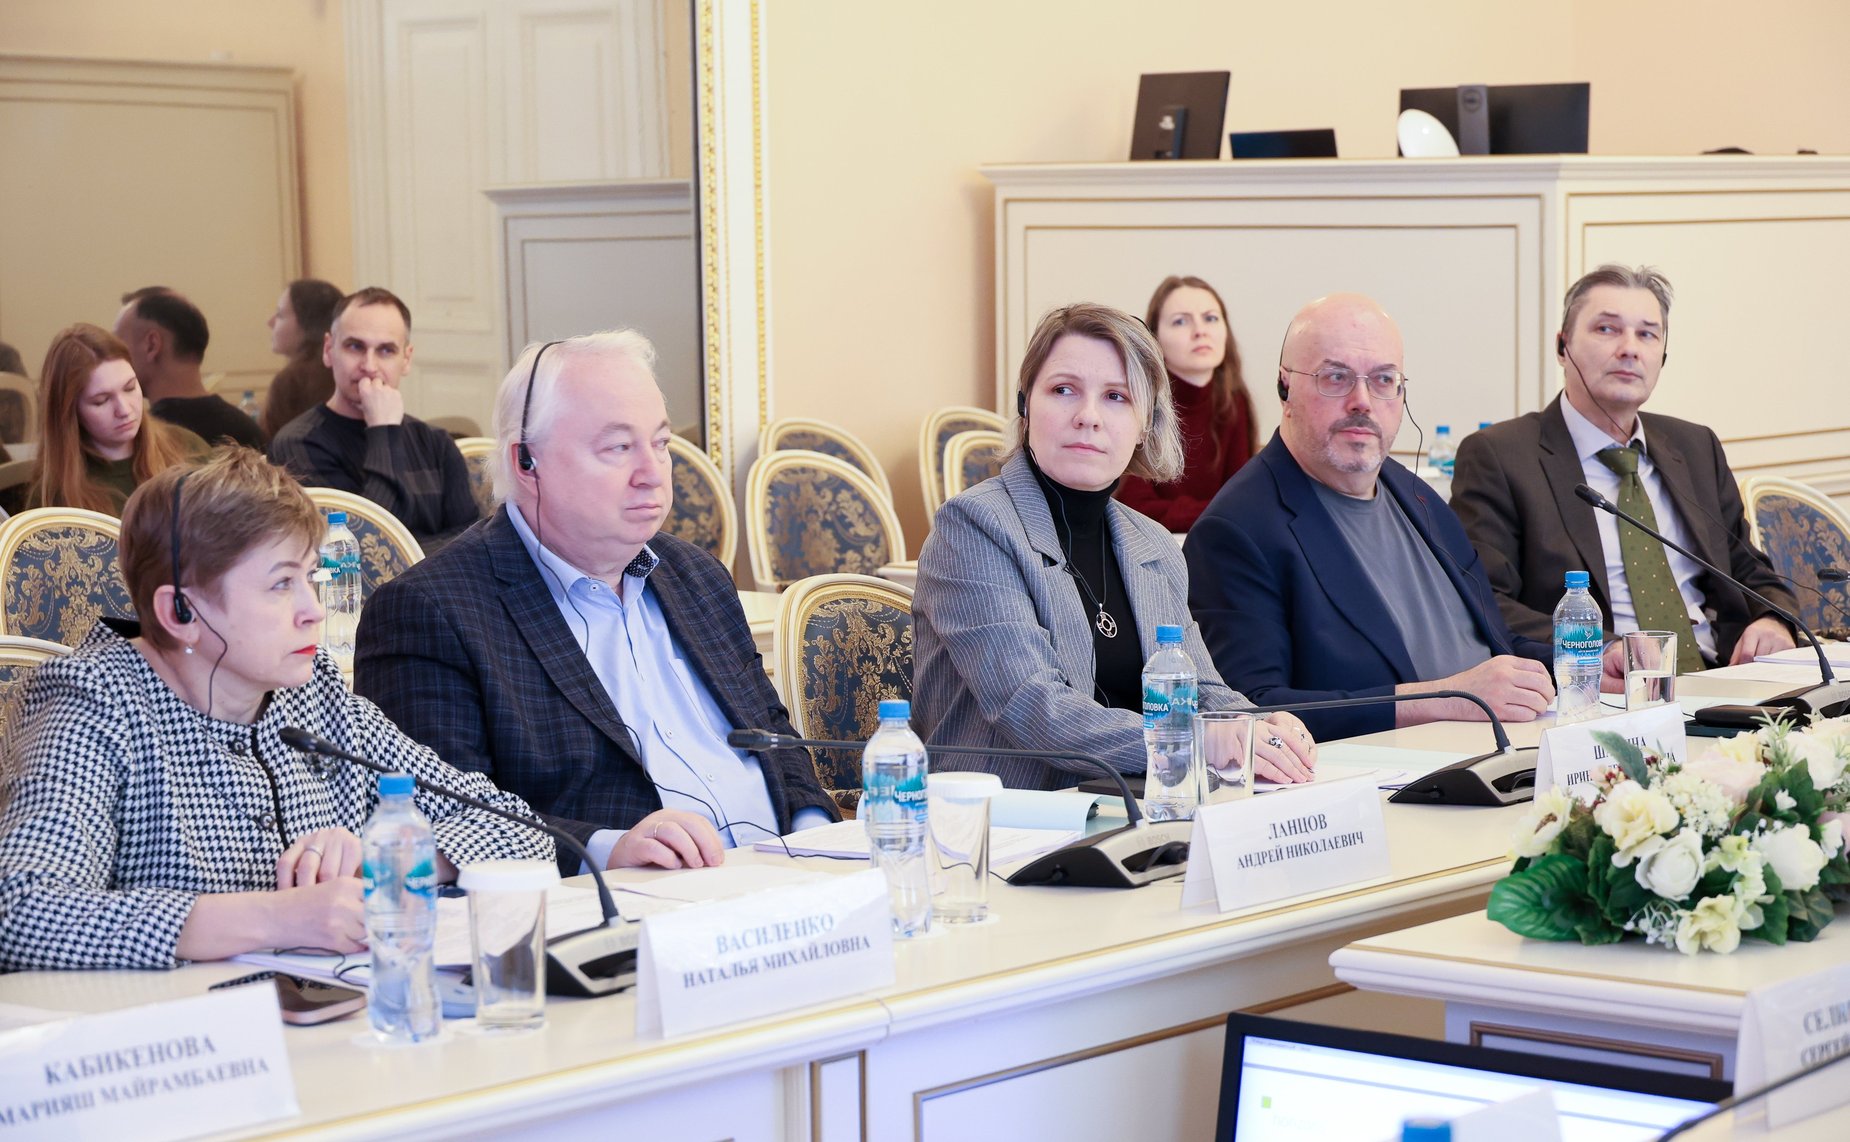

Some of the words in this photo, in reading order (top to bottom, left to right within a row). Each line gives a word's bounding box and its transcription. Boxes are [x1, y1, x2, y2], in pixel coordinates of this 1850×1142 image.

[1268, 813, 1328, 840] ЛАНЦОВ
[1237, 845, 1284, 870] АНДРЕЙ
[1286, 831, 1365, 860] НИКОЛАЕВИЧ
[716, 912, 835, 955] ВАСИЛЕНКО
[683, 958, 760, 989] НАТАЛЬЯ
[764, 935, 871, 971] МИХАЙЛОВНА
[43, 1034, 217, 1085] КАБИКЕНОВА
[99, 1056, 270, 1105] МАЙРАМБАЕВНА
